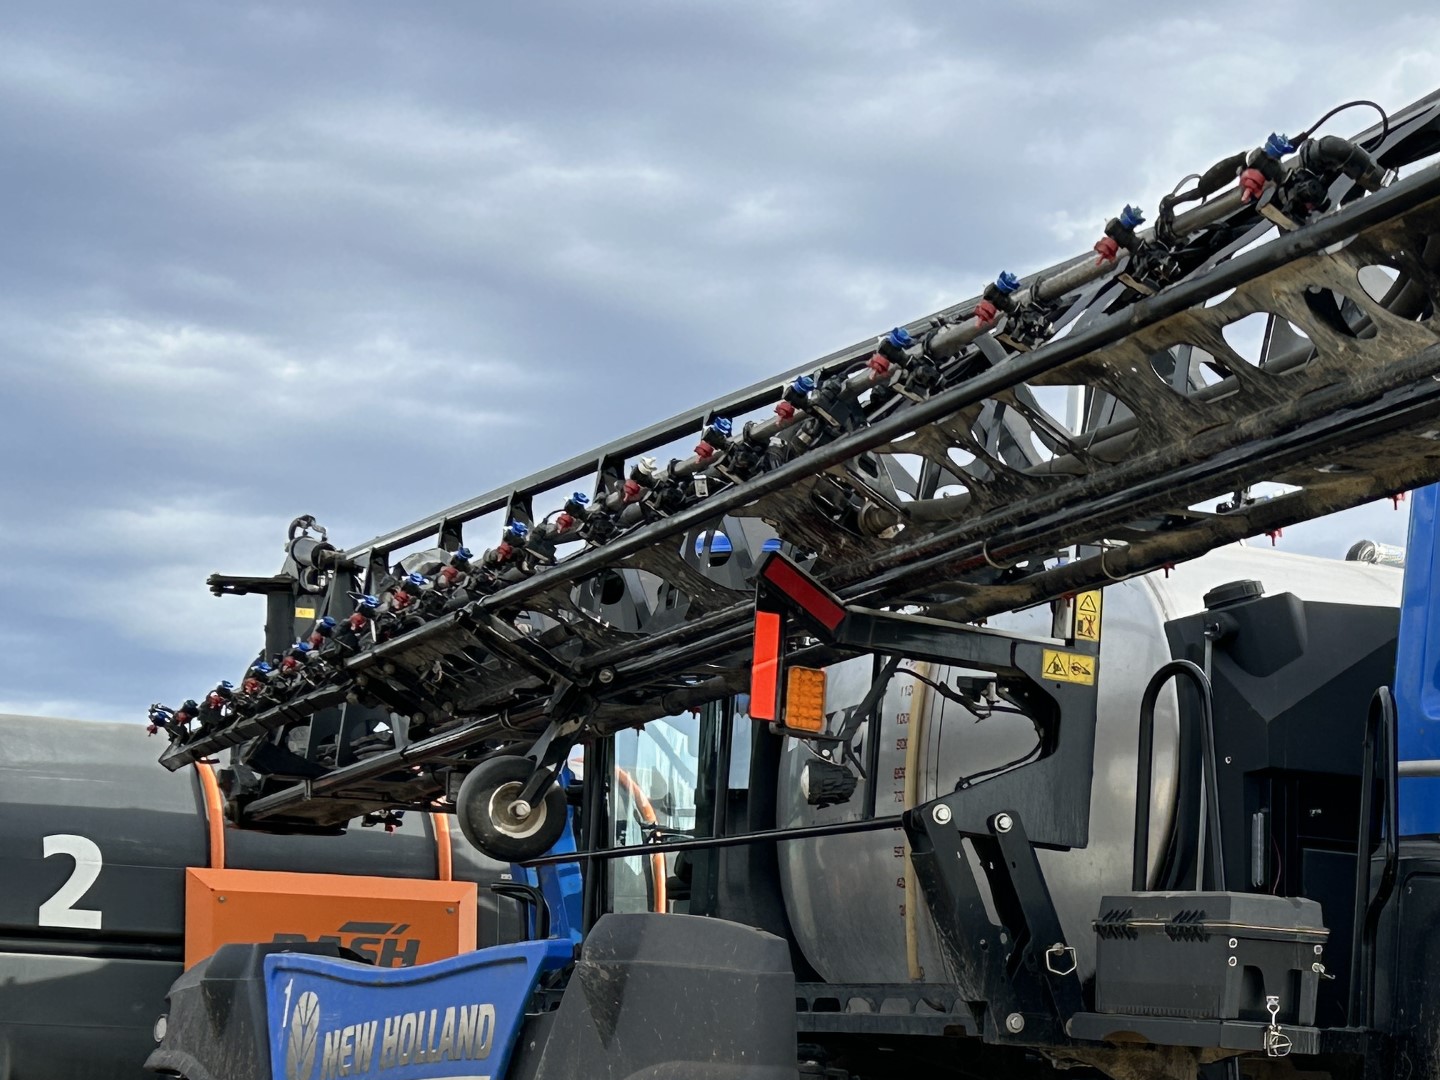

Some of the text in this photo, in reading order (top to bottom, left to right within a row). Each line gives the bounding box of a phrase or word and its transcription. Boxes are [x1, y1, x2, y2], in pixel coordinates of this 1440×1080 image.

[39, 834, 102, 929] 2
[272, 933, 420, 968] SH
[379, 1003, 496, 1071] HOLLAND
